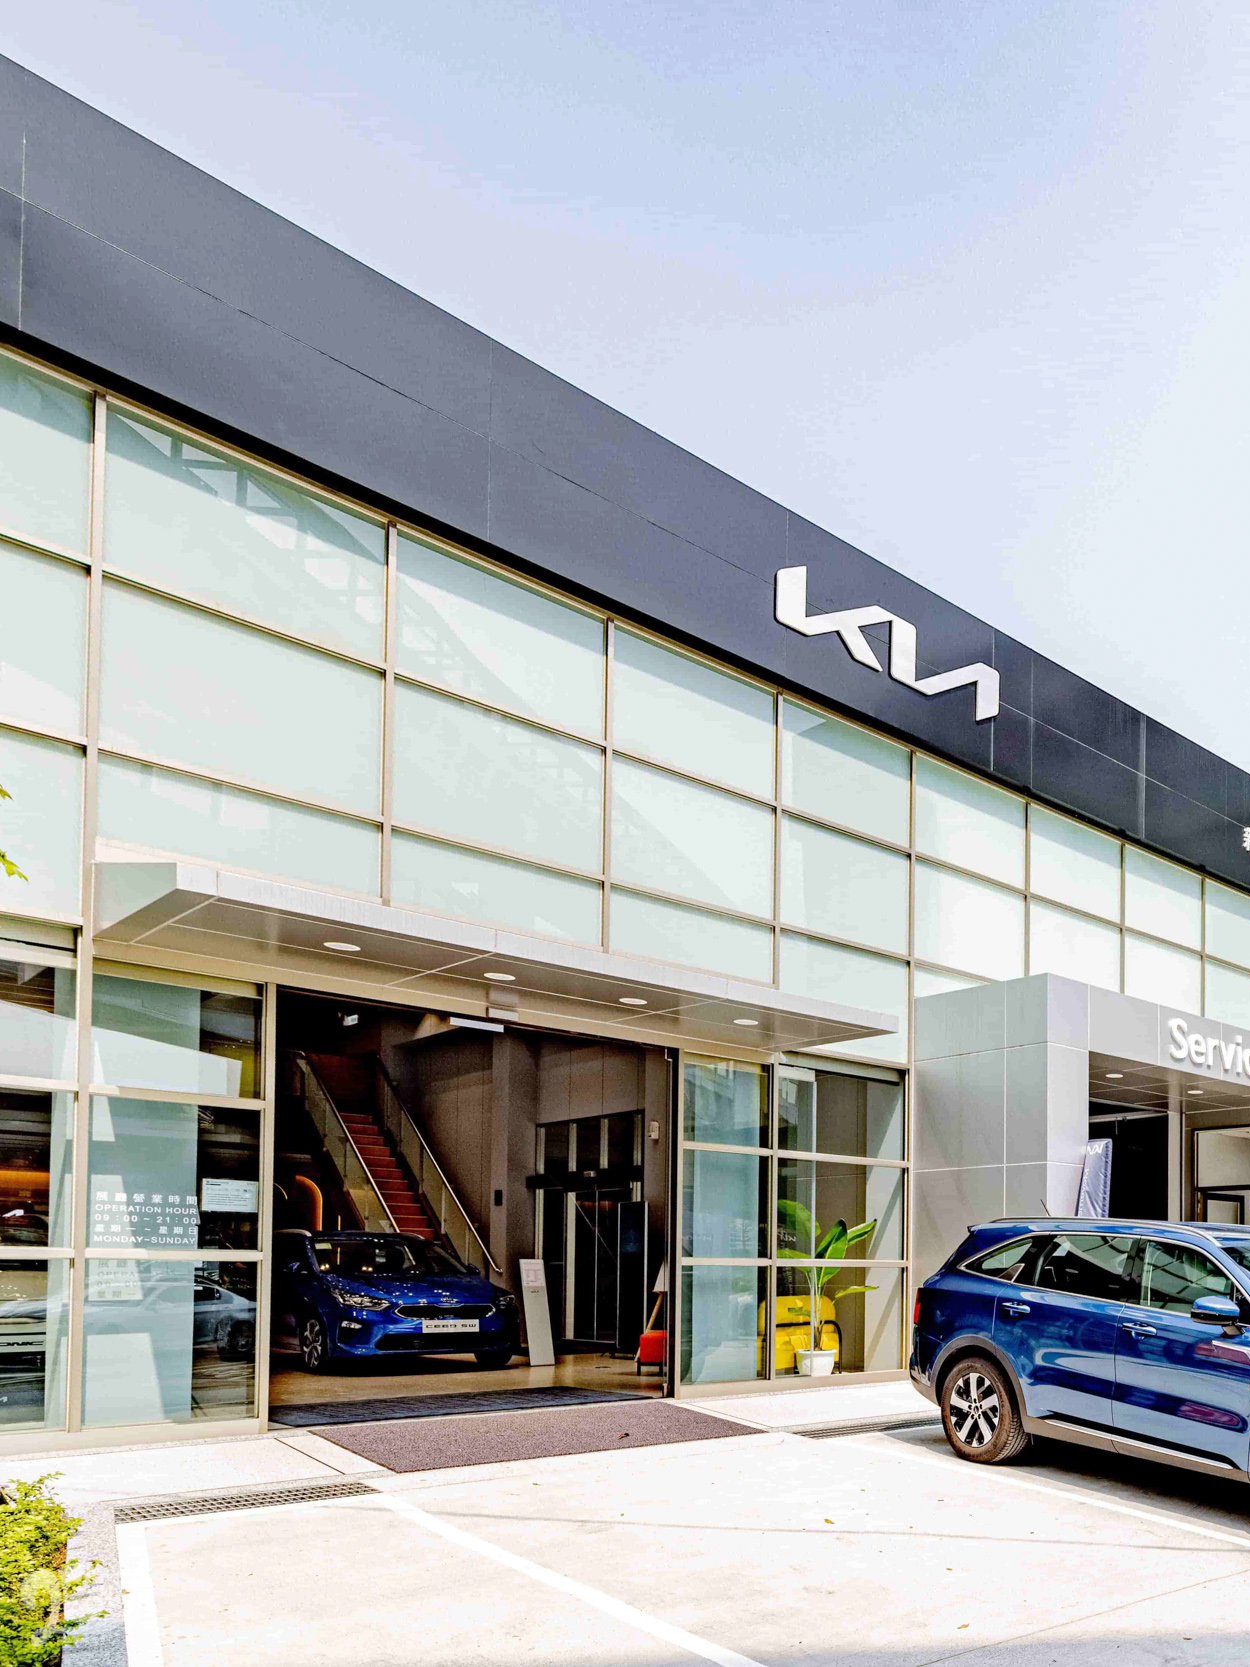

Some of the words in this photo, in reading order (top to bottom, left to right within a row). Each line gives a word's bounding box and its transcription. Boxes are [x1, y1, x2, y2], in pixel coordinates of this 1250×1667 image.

[775, 565, 1000, 722] KIA
[95, 1191, 198, 1206] 展廳營業時間
[95, 1203, 162, 1213] OPERATION
[166, 1206, 197, 1215] HOUR
